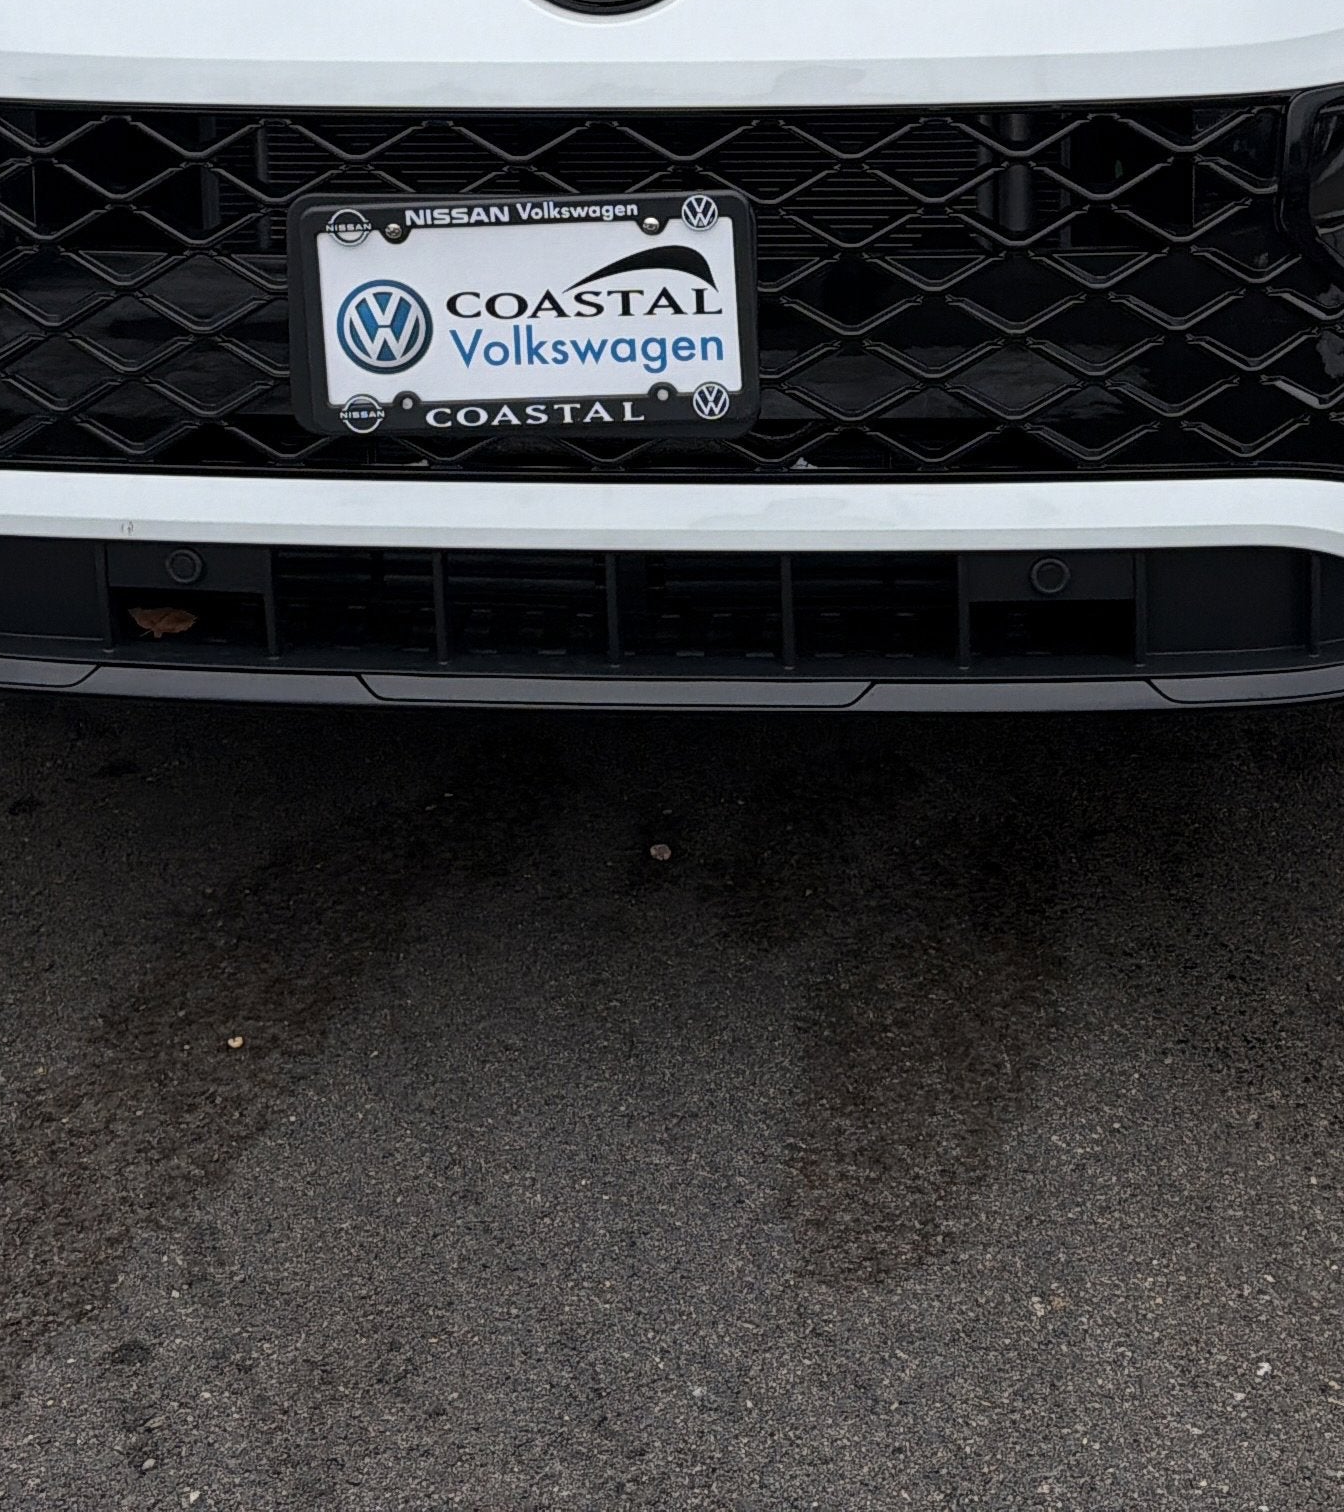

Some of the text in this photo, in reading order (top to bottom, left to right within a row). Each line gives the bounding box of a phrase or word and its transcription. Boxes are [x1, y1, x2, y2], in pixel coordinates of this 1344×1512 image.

[405, 201, 639, 226] NISSAN Volkswagen
[682, 195, 718, 230] VW
[445, 285, 724, 320] COASTAL
[340, 282, 431, 371] VW
[448, 324, 725, 374] Volkswagen
[425, 400, 645, 428] COASTAL
[693, 384, 729, 419] VW
